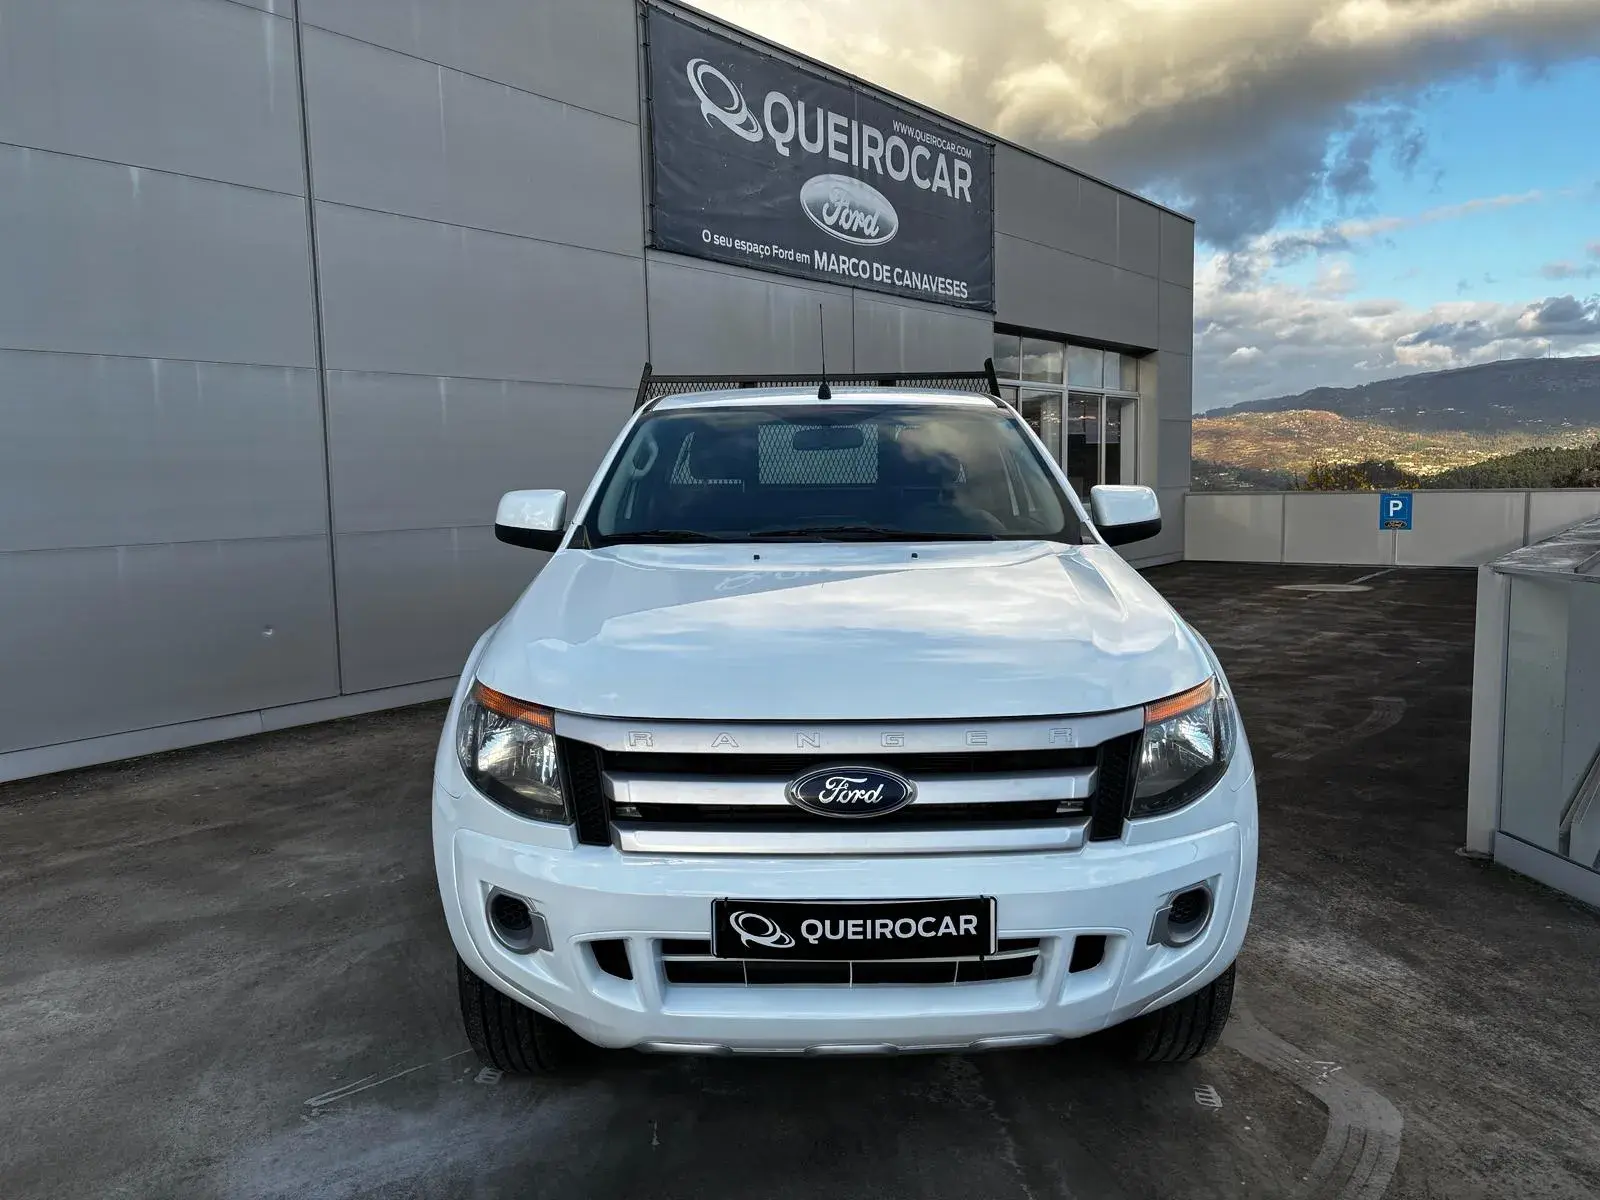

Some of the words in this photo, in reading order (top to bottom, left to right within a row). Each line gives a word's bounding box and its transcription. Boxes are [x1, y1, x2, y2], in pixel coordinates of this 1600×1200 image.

[764, 91, 972, 203] QUEIROCAR
[893, 120, 972, 159] WWW.QUEIROCAR.COM
[822, 187, 880, 237] Ford
[702, 229, 712, 243] O
[713, 234, 733, 249] seu
[734, 239, 771, 258] espaço
[772, 245, 794, 261] Ford
[795, 252, 811, 264] em
[814, 250, 870, 279] MARCO
[873, 263, 891, 283] DE
[894, 267, 968, 299] CANAVESES
[1389, 500, 1402, 516] P
[628, 727, 1073, 749] RANGER
[818, 776, 883, 805] Ford
[801, 914, 978, 945] QUEIROCAR
